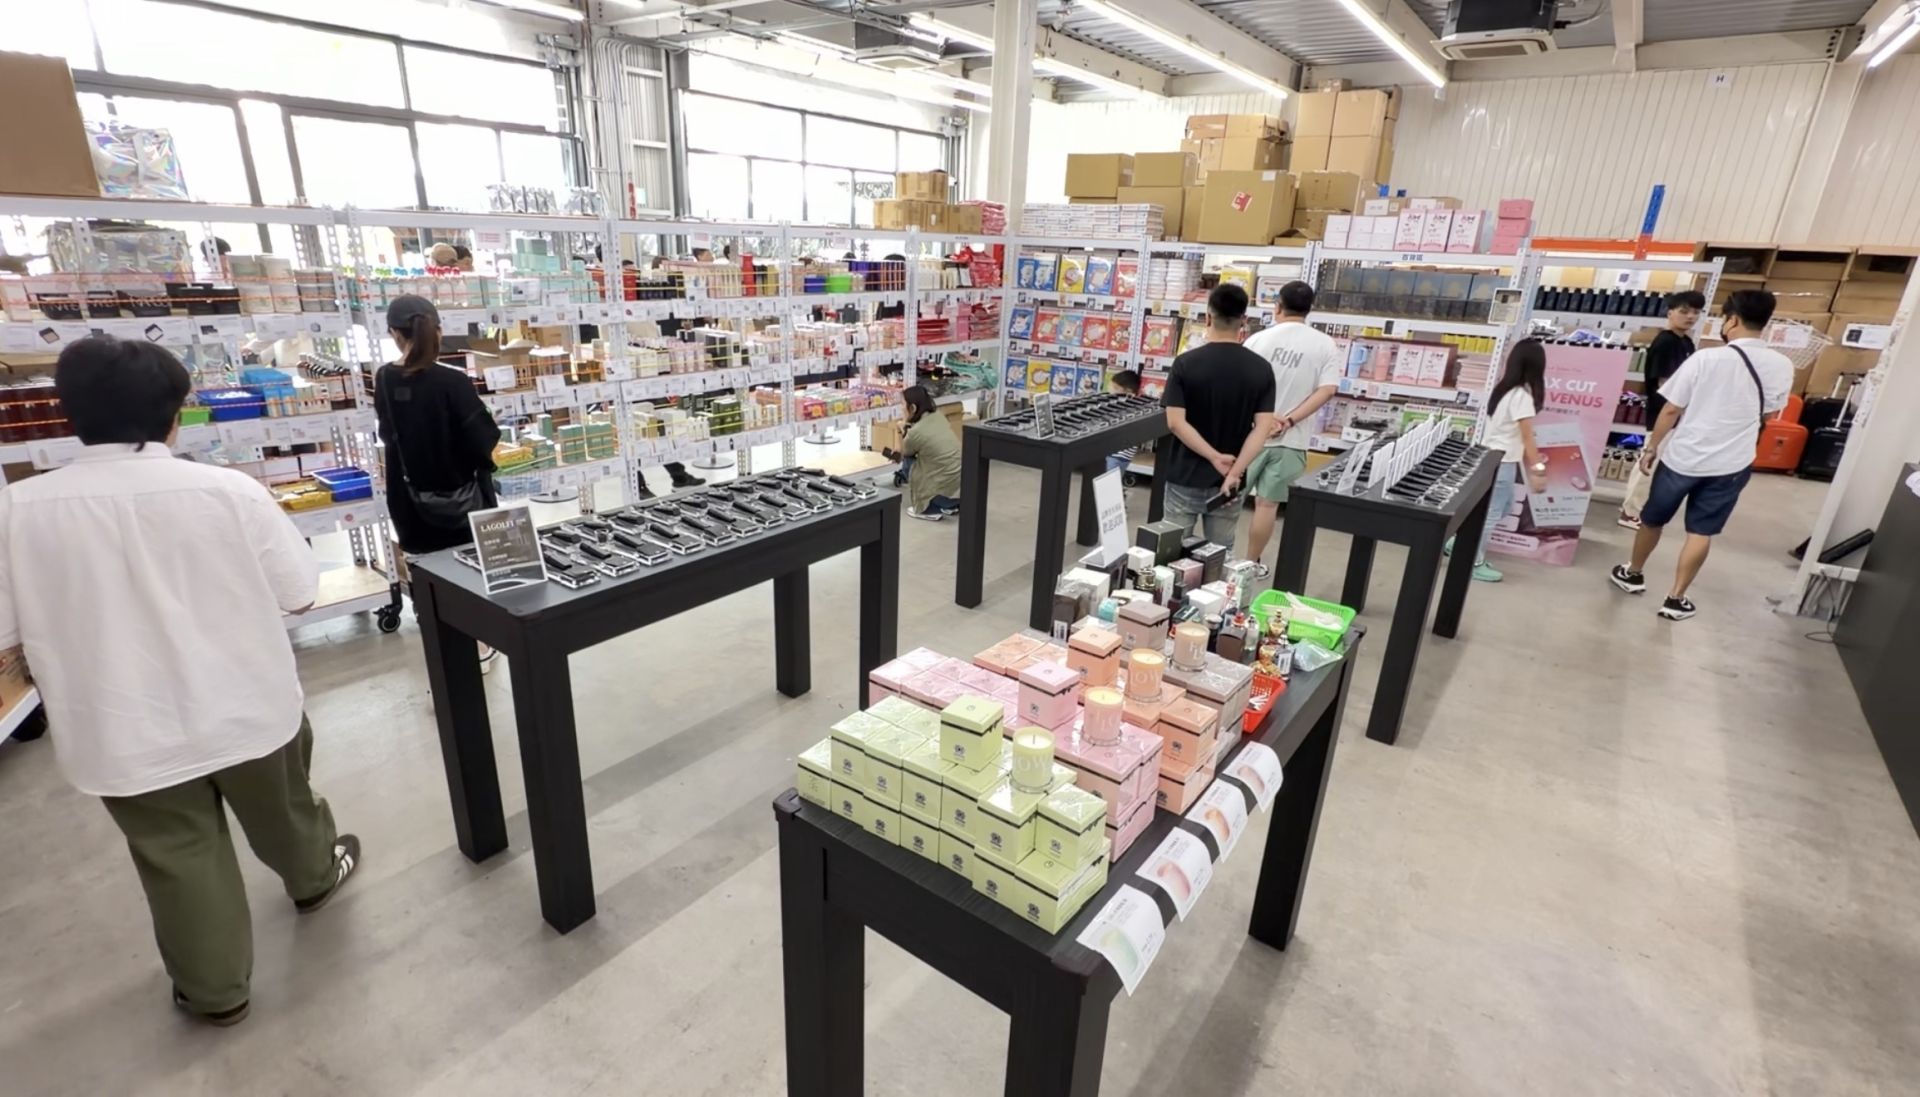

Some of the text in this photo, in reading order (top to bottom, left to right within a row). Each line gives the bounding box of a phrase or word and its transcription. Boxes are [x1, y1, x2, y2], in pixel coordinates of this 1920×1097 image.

[1270, 347, 1304, 369] RUN
[1566, 379, 1598, 393] CUT
[1550, 391, 1603, 407] VENUS
